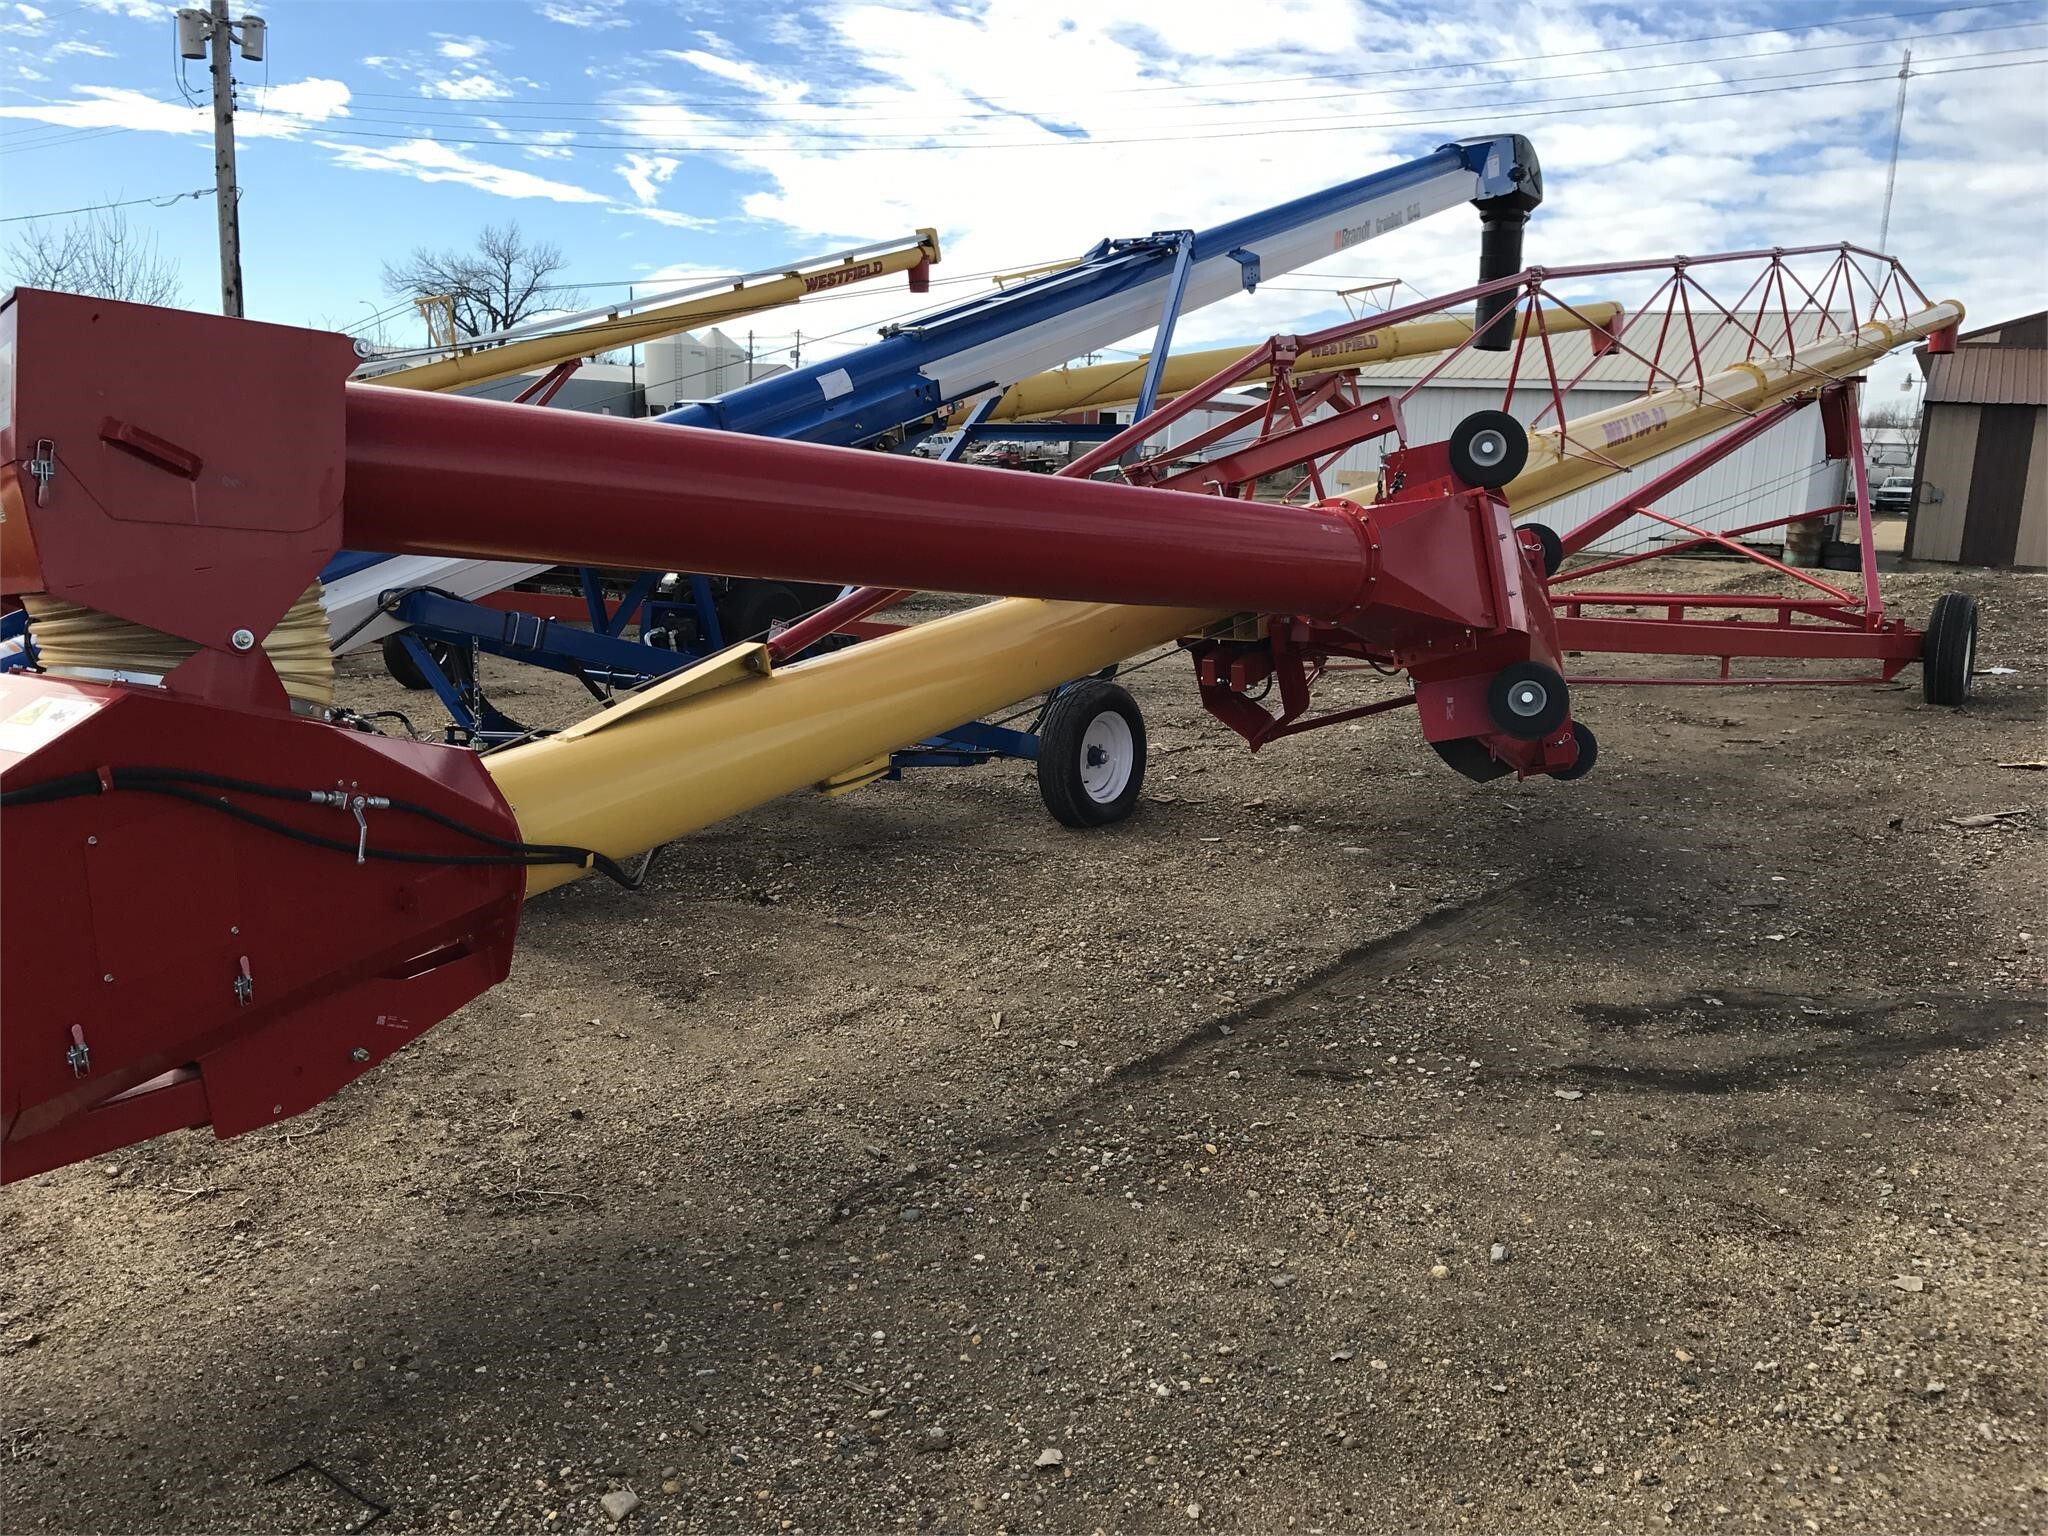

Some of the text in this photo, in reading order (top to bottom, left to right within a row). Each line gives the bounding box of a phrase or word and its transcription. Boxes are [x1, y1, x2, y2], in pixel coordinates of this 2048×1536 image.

[1340, 219, 1371, 248] Brandt
[804, 260, 883, 293] WESTFIELD
[1311, 334, 1378, 358] WESTFIELD
